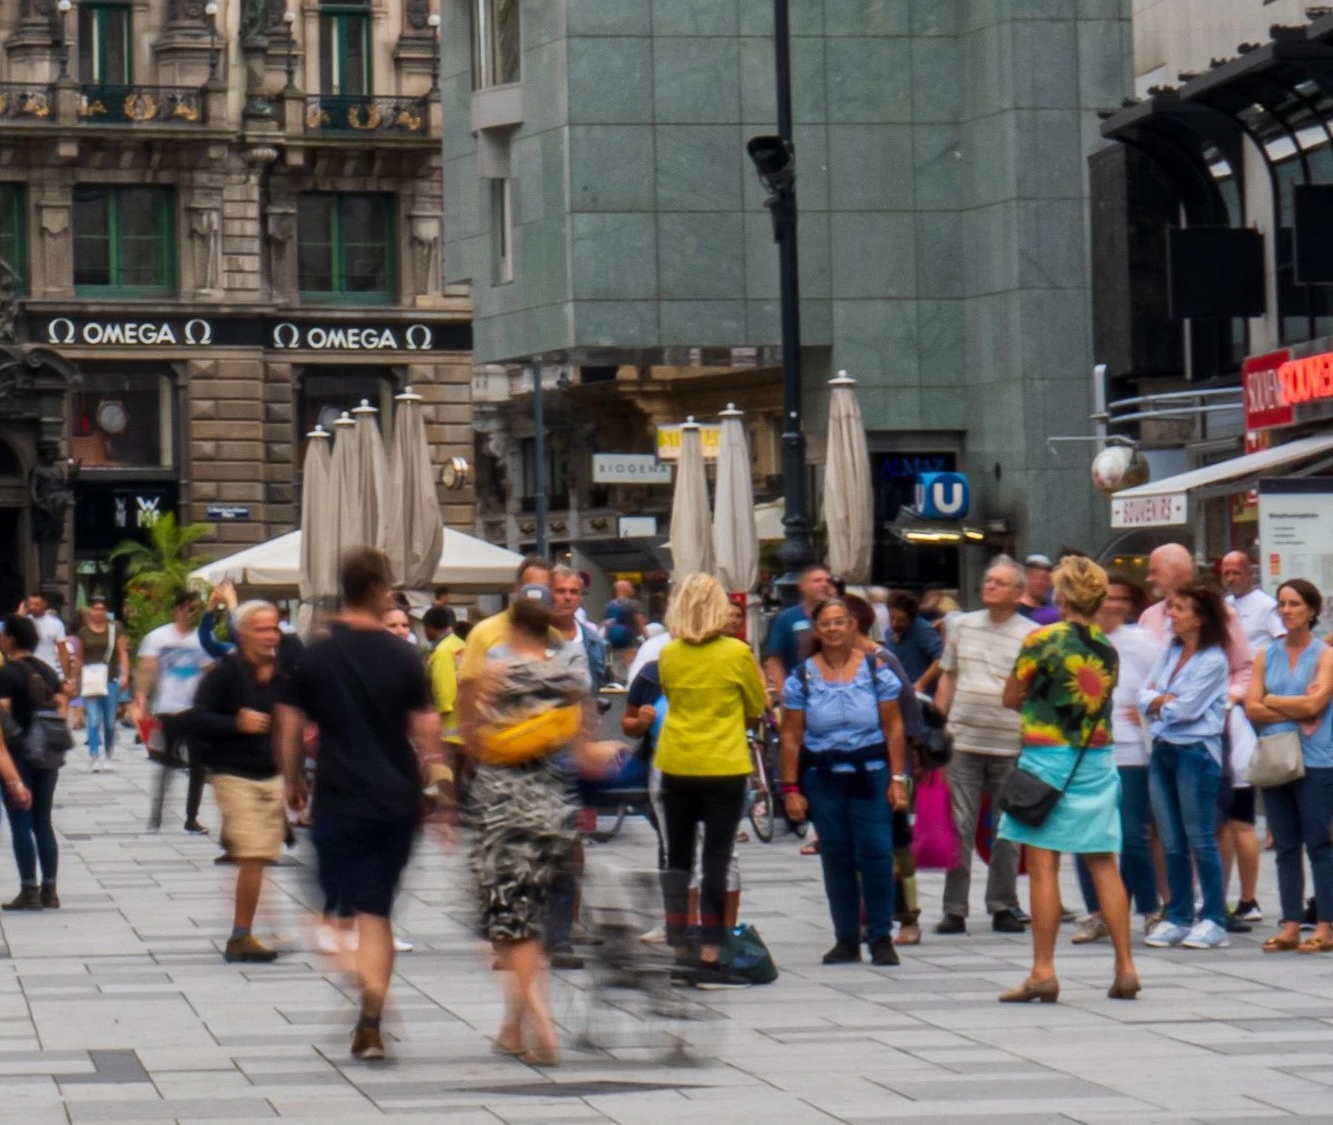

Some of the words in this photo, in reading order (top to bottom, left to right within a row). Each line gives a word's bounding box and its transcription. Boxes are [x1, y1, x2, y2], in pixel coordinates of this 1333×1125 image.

[83, 322, 176, 344] OMEGA
[307, 327, 397, 349] OMEGA
[598, 463, 669, 473] BIOGENA
[933, 482, 963, 514] U
[1123, 496, 1172, 523] SOUVENIRS
